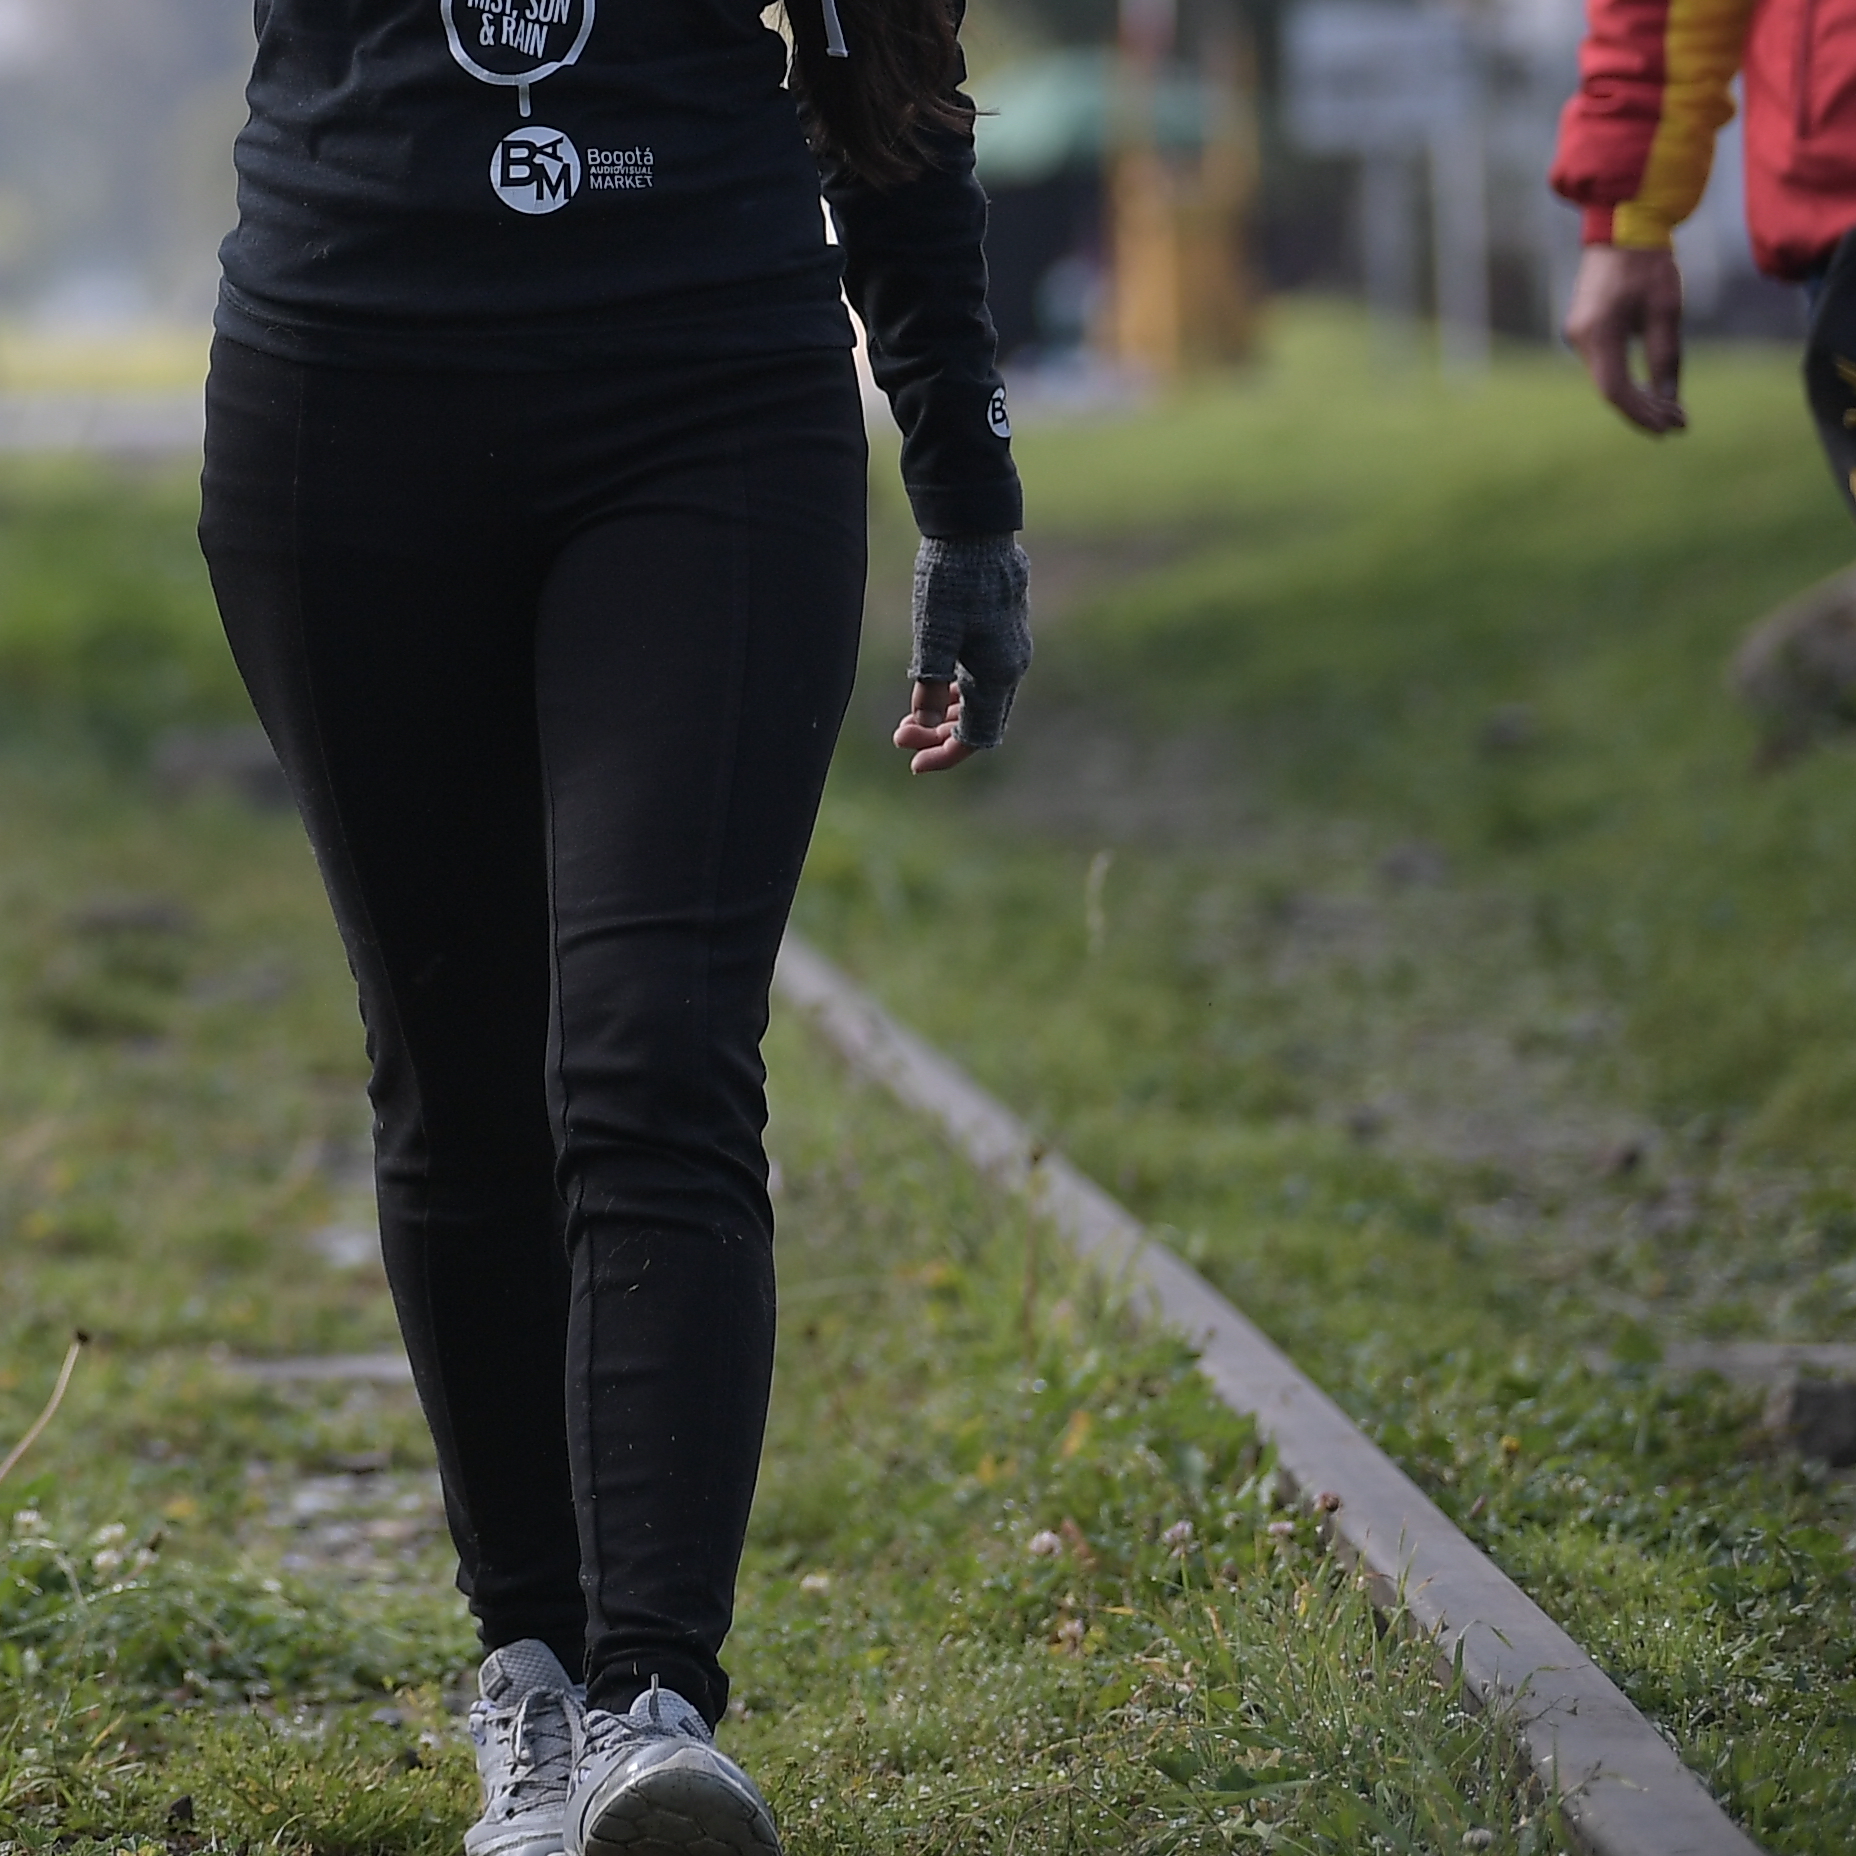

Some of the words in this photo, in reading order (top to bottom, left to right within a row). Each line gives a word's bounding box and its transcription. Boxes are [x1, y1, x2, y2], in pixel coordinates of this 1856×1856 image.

[479, 13, 495, 46] &
[500, 15, 549, 59] RAIN
[587, 146, 654, 169] Bogotá
[590, 165, 653, 175] AUDIOVISUAL
[590, 174, 653, 190] MARKET
